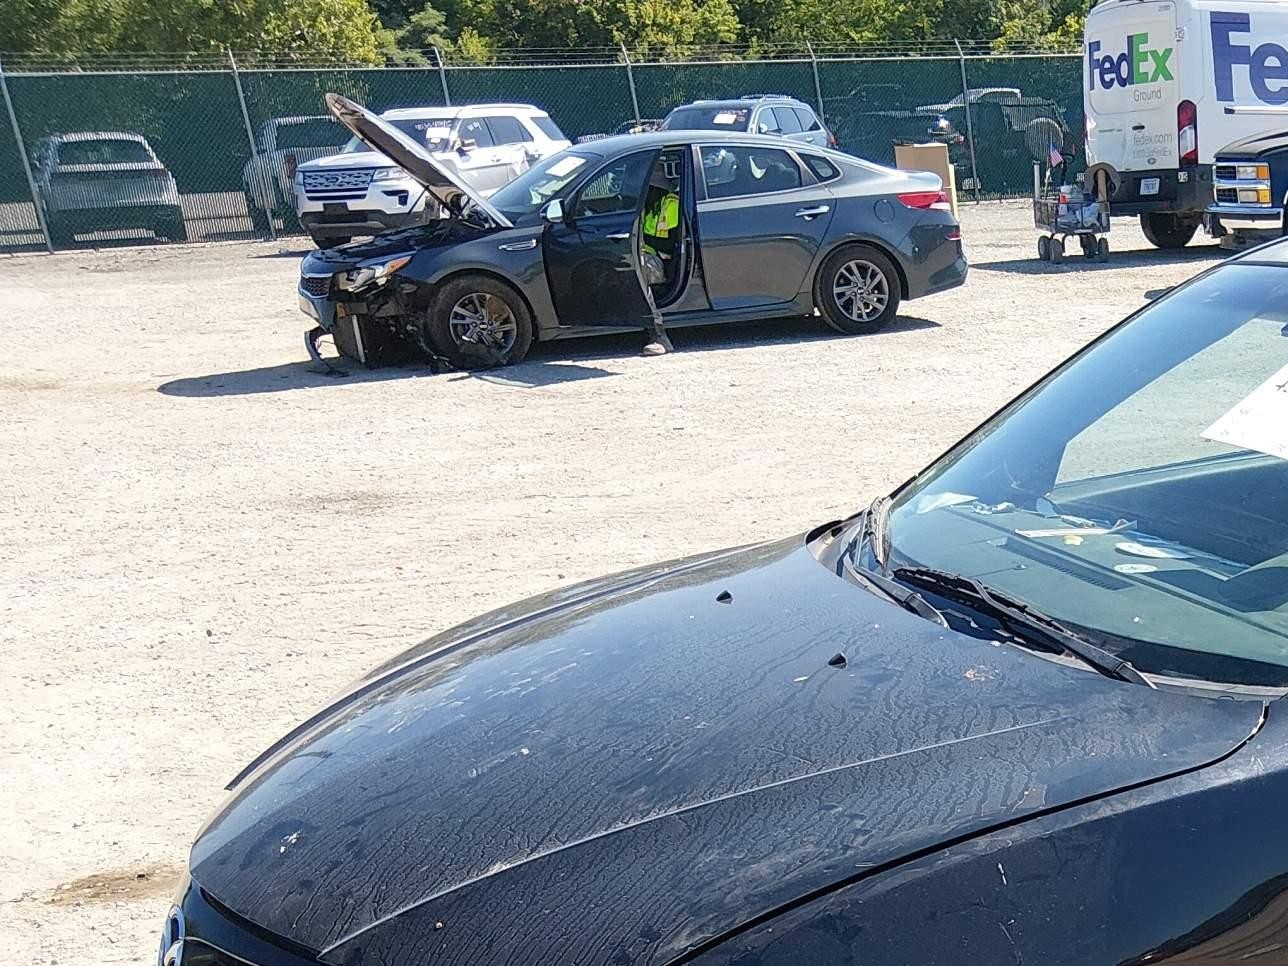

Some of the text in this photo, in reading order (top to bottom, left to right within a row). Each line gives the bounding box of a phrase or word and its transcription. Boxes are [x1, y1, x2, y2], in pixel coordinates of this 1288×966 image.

[1088, 32, 1174, 91] FedEx
[1133, 87, 1162, 102] Ground
[1132, 133, 1173, 147] fedex.com
